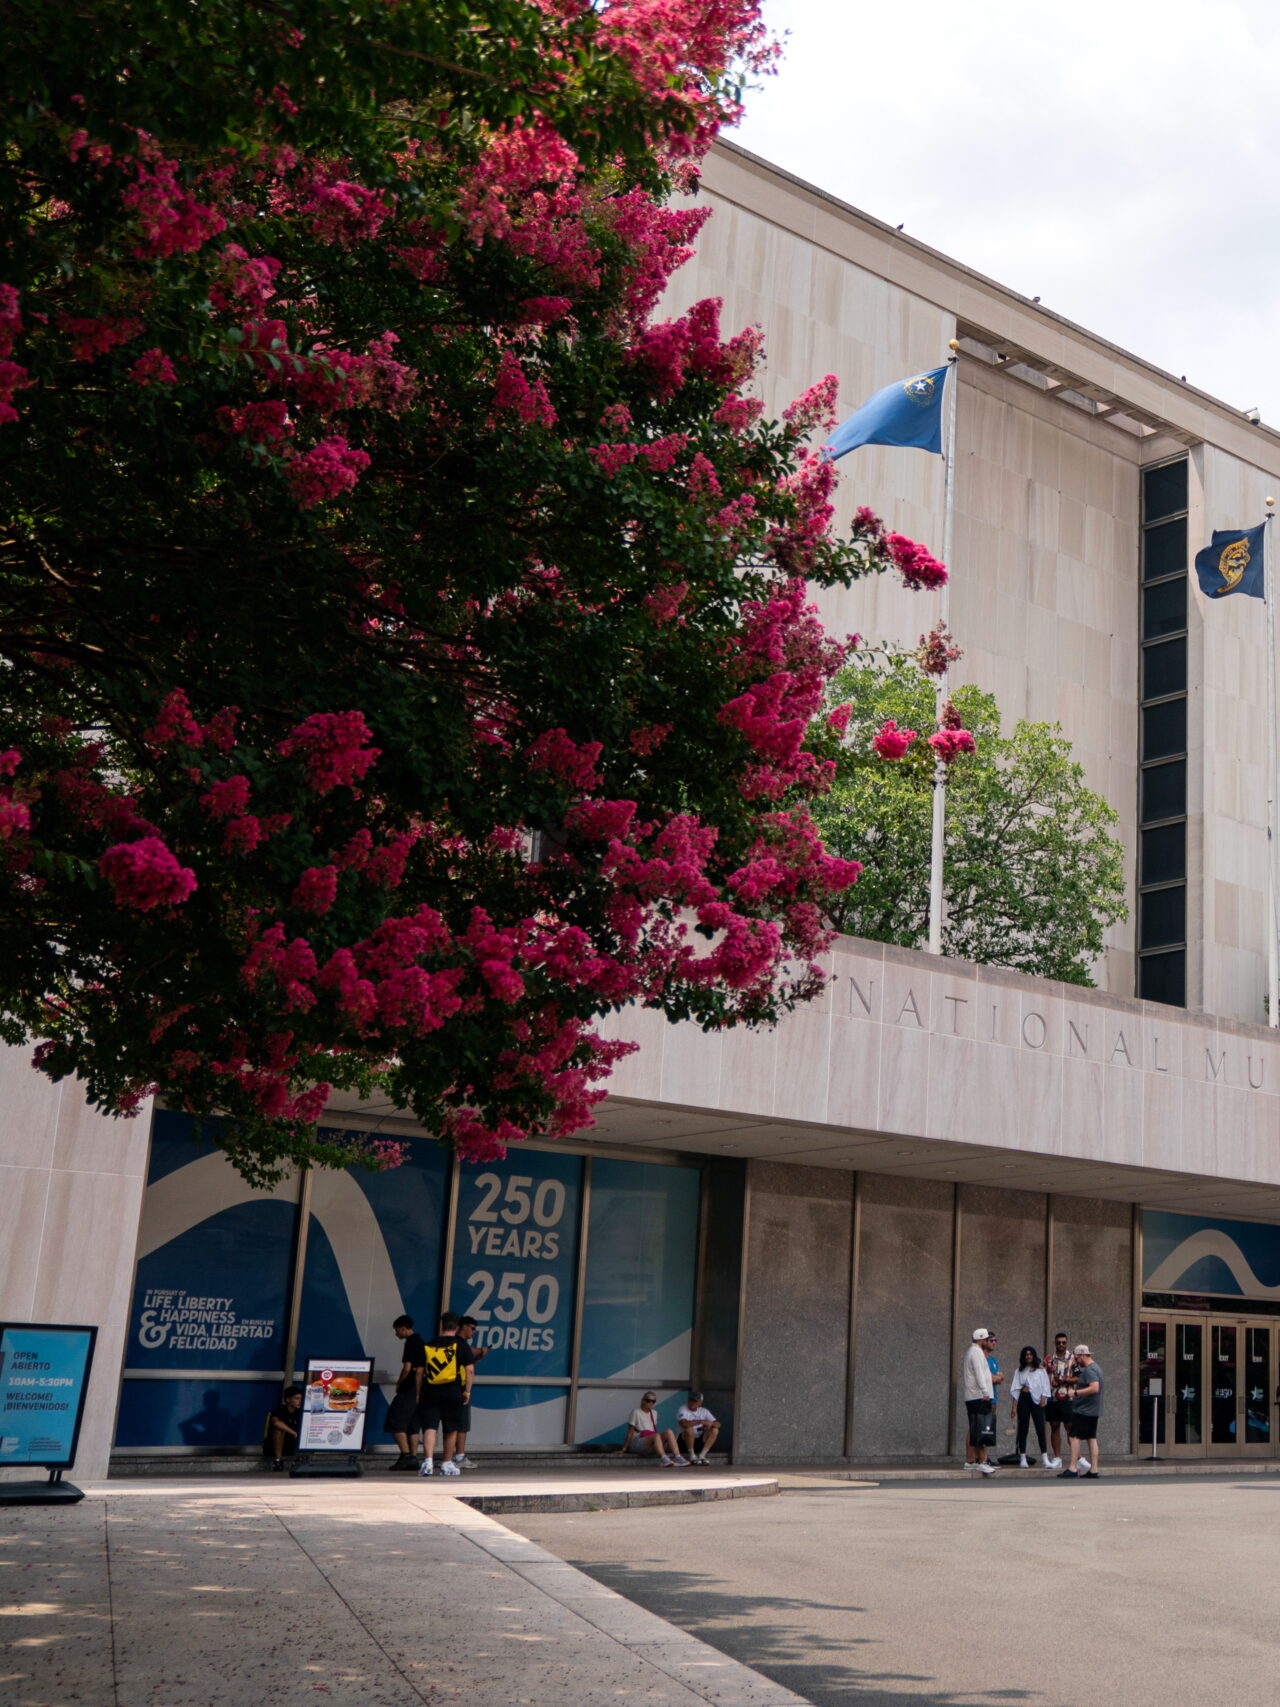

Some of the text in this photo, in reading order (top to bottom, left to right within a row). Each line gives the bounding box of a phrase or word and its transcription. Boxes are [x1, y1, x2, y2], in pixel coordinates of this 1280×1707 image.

[849, 976, 1168, 1072] NATIONAL
[468, 1172, 566, 1227] 250
[467, 1225, 561, 1260] YEARS
[143, 1295, 234, 1311] LIFE, LIBERTY
[463, 1270, 560, 1324] 250
[138, 1309, 236, 1349] & HAPPINESS
[175, 1323, 274, 1338] VIDA, LIBERTAD
[168, 1336, 238, 1350] FELICIDAD
[467, 1325, 555, 1352] TORIES
[13, 1351, 38, 1360] OPEN
[1184, 1353, 1194, 1361] EXIT
[1219, 1354, 1229, 1362] EXIT
[10, 1362, 51, 1370] ABIERTO
[8, 1377, 74, 1387] 10AM-5:30PM
[6, 1392, 53, 1401] WELCOME!
[3, 1402, 69, 1412] ¡BIENVENIDOS!
